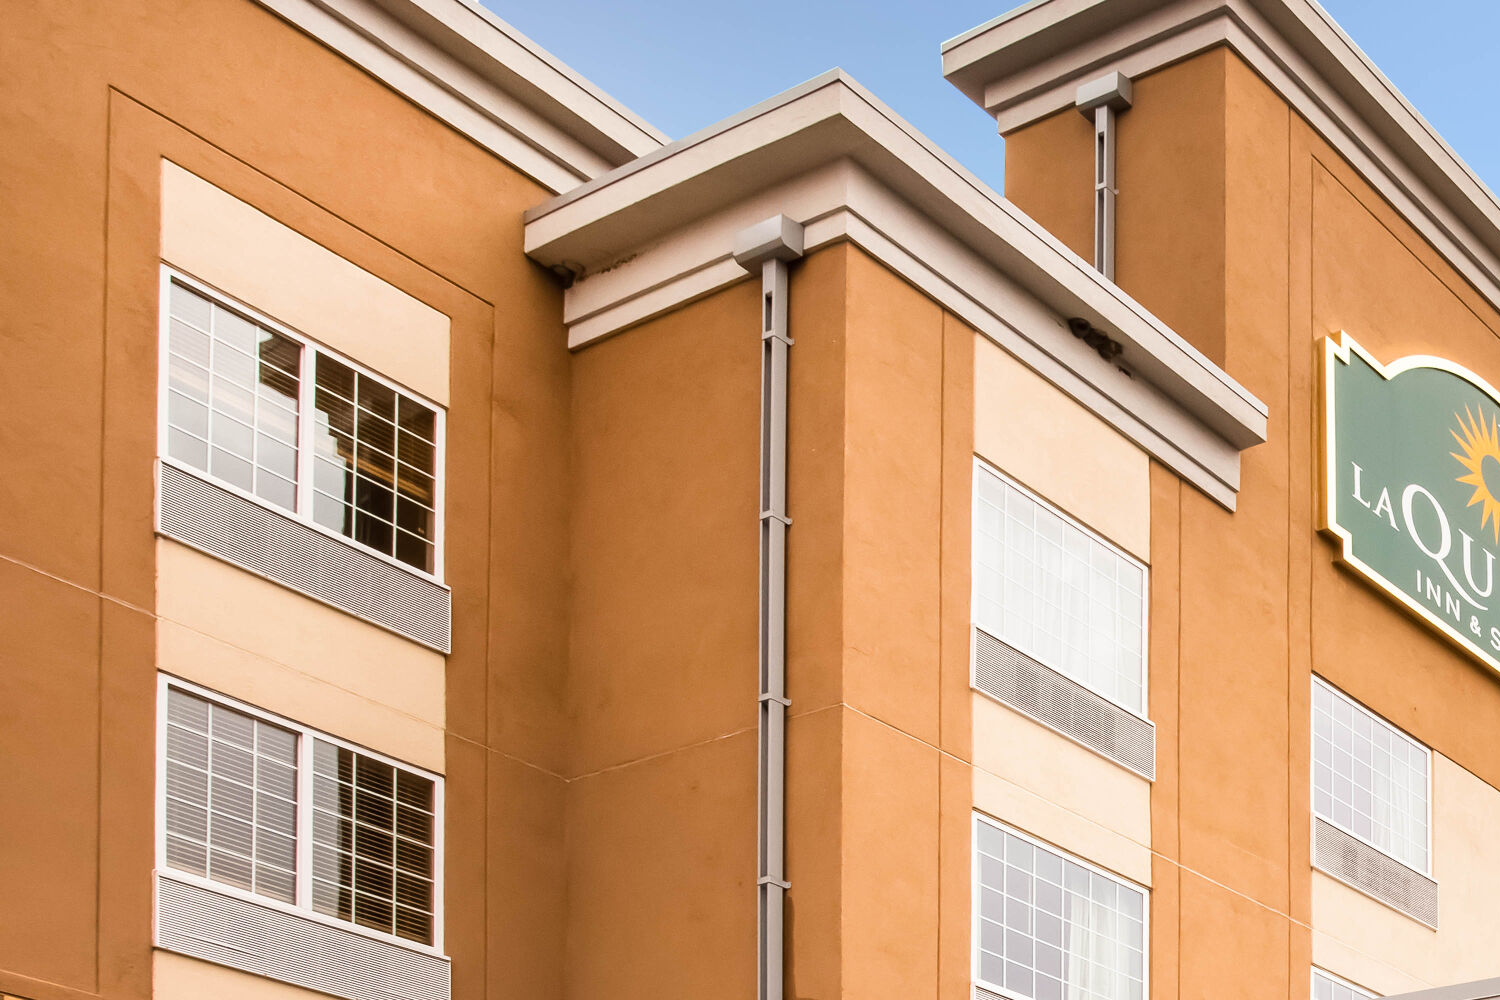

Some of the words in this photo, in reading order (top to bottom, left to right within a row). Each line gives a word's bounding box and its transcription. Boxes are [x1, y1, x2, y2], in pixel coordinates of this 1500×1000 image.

[1351, 461, 1400, 532] LA
[1416, 569, 1461, 622] INN
[1469, 615, 1482, 638] &
